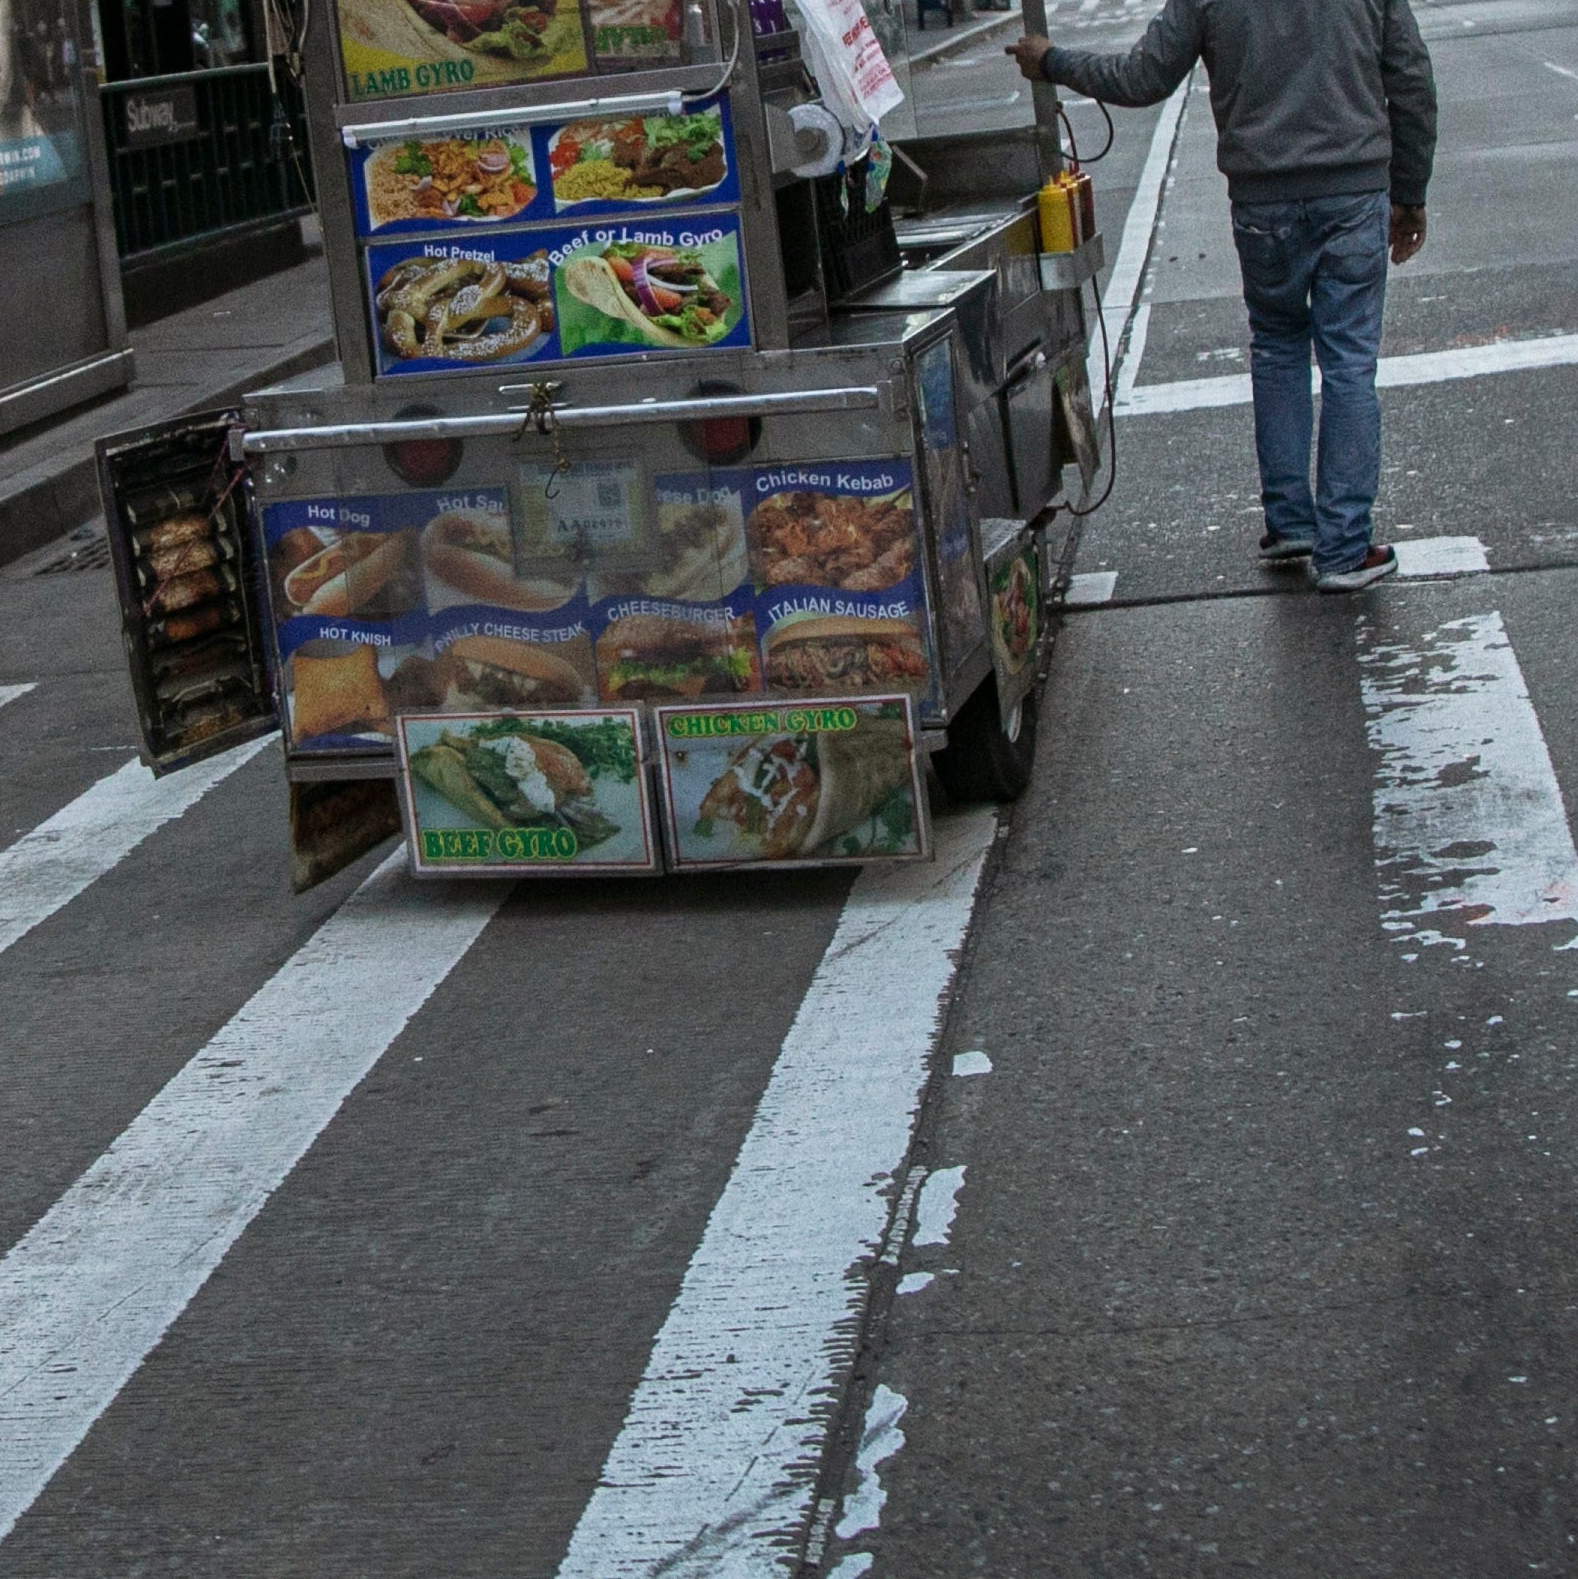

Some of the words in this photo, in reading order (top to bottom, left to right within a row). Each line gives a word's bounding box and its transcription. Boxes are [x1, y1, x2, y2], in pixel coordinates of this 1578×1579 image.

[350, 67, 411, 98] LAMB
[415, 59, 475, 89] GYRO
[127, 99, 174, 132] Subway
[424, 245, 448, 259] Hot
[450, 246, 495, 262] Pretzel
[548, 233, 590, 265] Beef
[594, 228, 617, 243] or
[622, 227, 674, 247] Lamb
[679, 228, 724, 247] Gyro
[755, 470, 831, 492] Chicken
[836, 472, 894, 491] Kebab
[308, 505, 335, 520] Hot
[339, 509, 370, 527] Dog
[436, 496, 471, 513] Hot
[607, 600, 736, 622] CHEESEBURGER
[768, 598, 831, 622] ITALIAN
[835, 599, 910, 620] SAUSAGE
[320, 627, 348, 641] HOT
[351, 628, 391, 648] KNISH
[435, 622, 481, 652] PHILLY
[484, 623, 539, 643] CHEESE
[541, 621, 587, 643] STEAK
[667, 708, 782, 739] CHICKEN
[785, 706, 858, 732] GYRO
[424, 829, 495, 860] BEEF
[498, 828, 577, 859] GYRO
